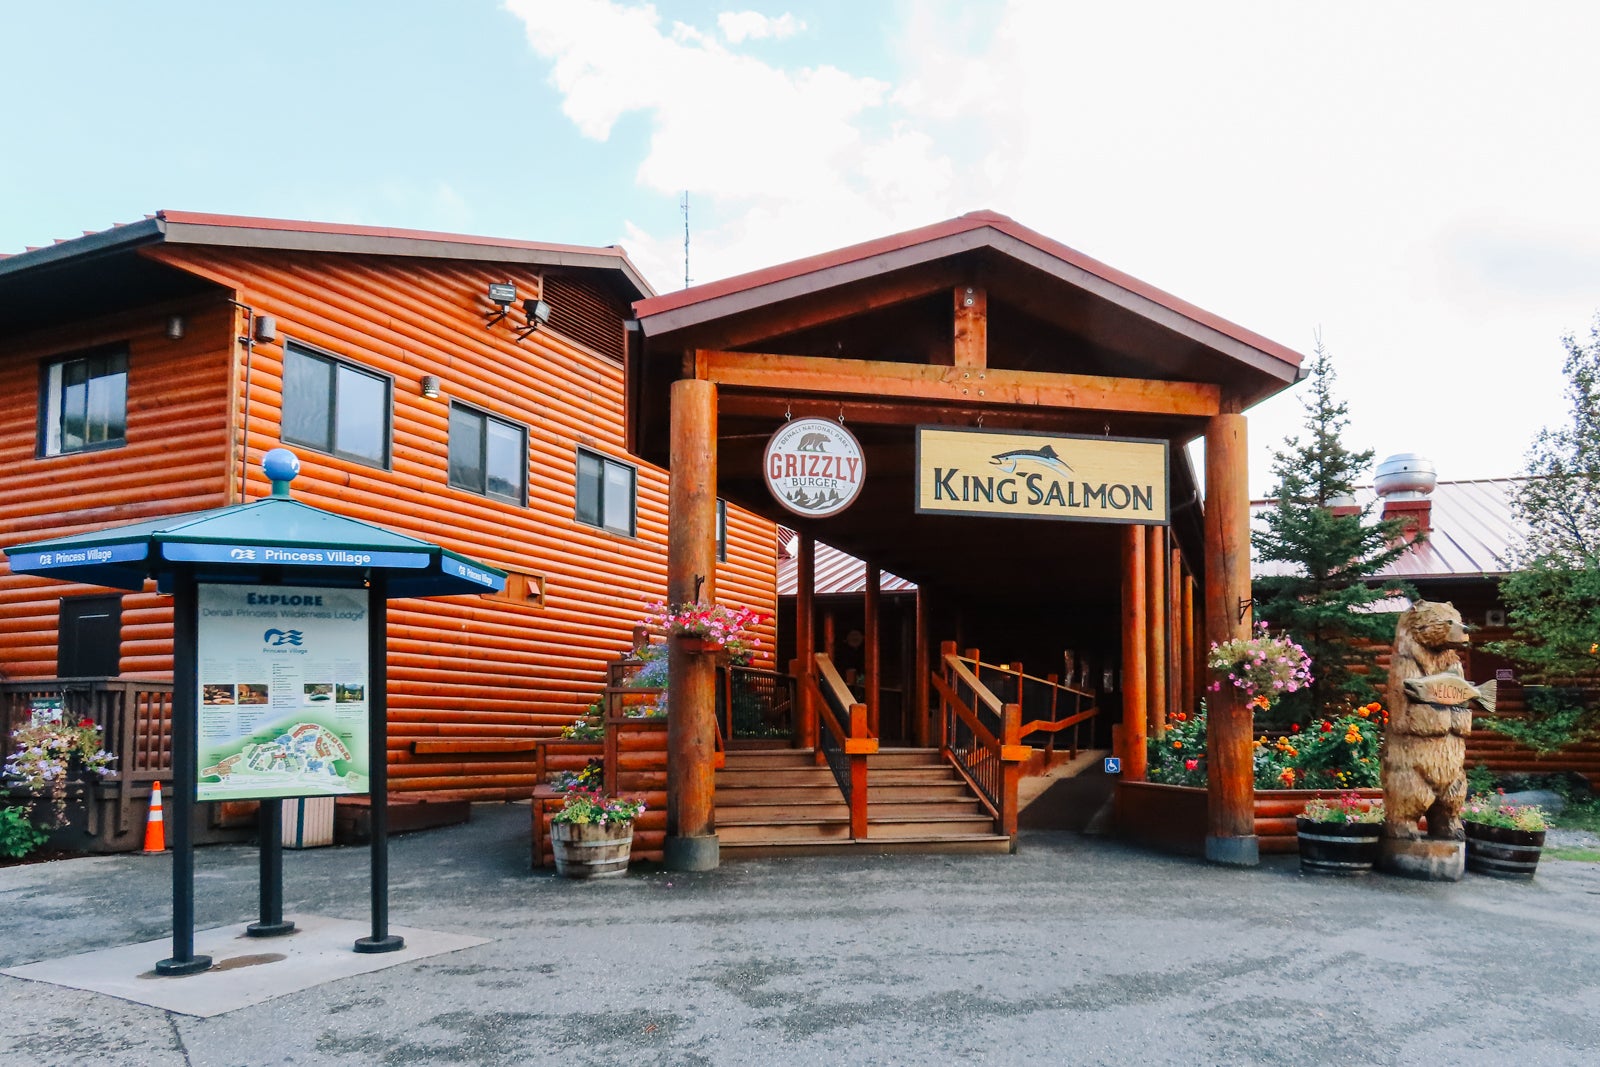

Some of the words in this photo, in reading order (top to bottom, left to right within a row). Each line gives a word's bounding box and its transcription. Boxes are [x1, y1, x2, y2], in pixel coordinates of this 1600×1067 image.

[780, 428, 801, 445] DENALI
[802, 424, 834, 435] NATIONAL
[834, 433, 849, 448] PARK
[770, 452, 859, 483] GRIZZLY
[791, 477, 838, 488] BURGER
[933, 467, 1018, 505] KING
[1026, 473, 1153, 511] SALMON
[55, 553, 86, 564] Princess
[87, 549, 112, 562] Village
[265, 549, 323, 561] Princess
[326, 551, 371, 565] Village
[247, 592, 323, 606] EXPLORE
[202, 607, 234, 617] Denali
[236, 608, 278, 618] Princess
[279, 609, 332, 619] Wilderness
[1432, 682, 1469, 700] WELCOME
